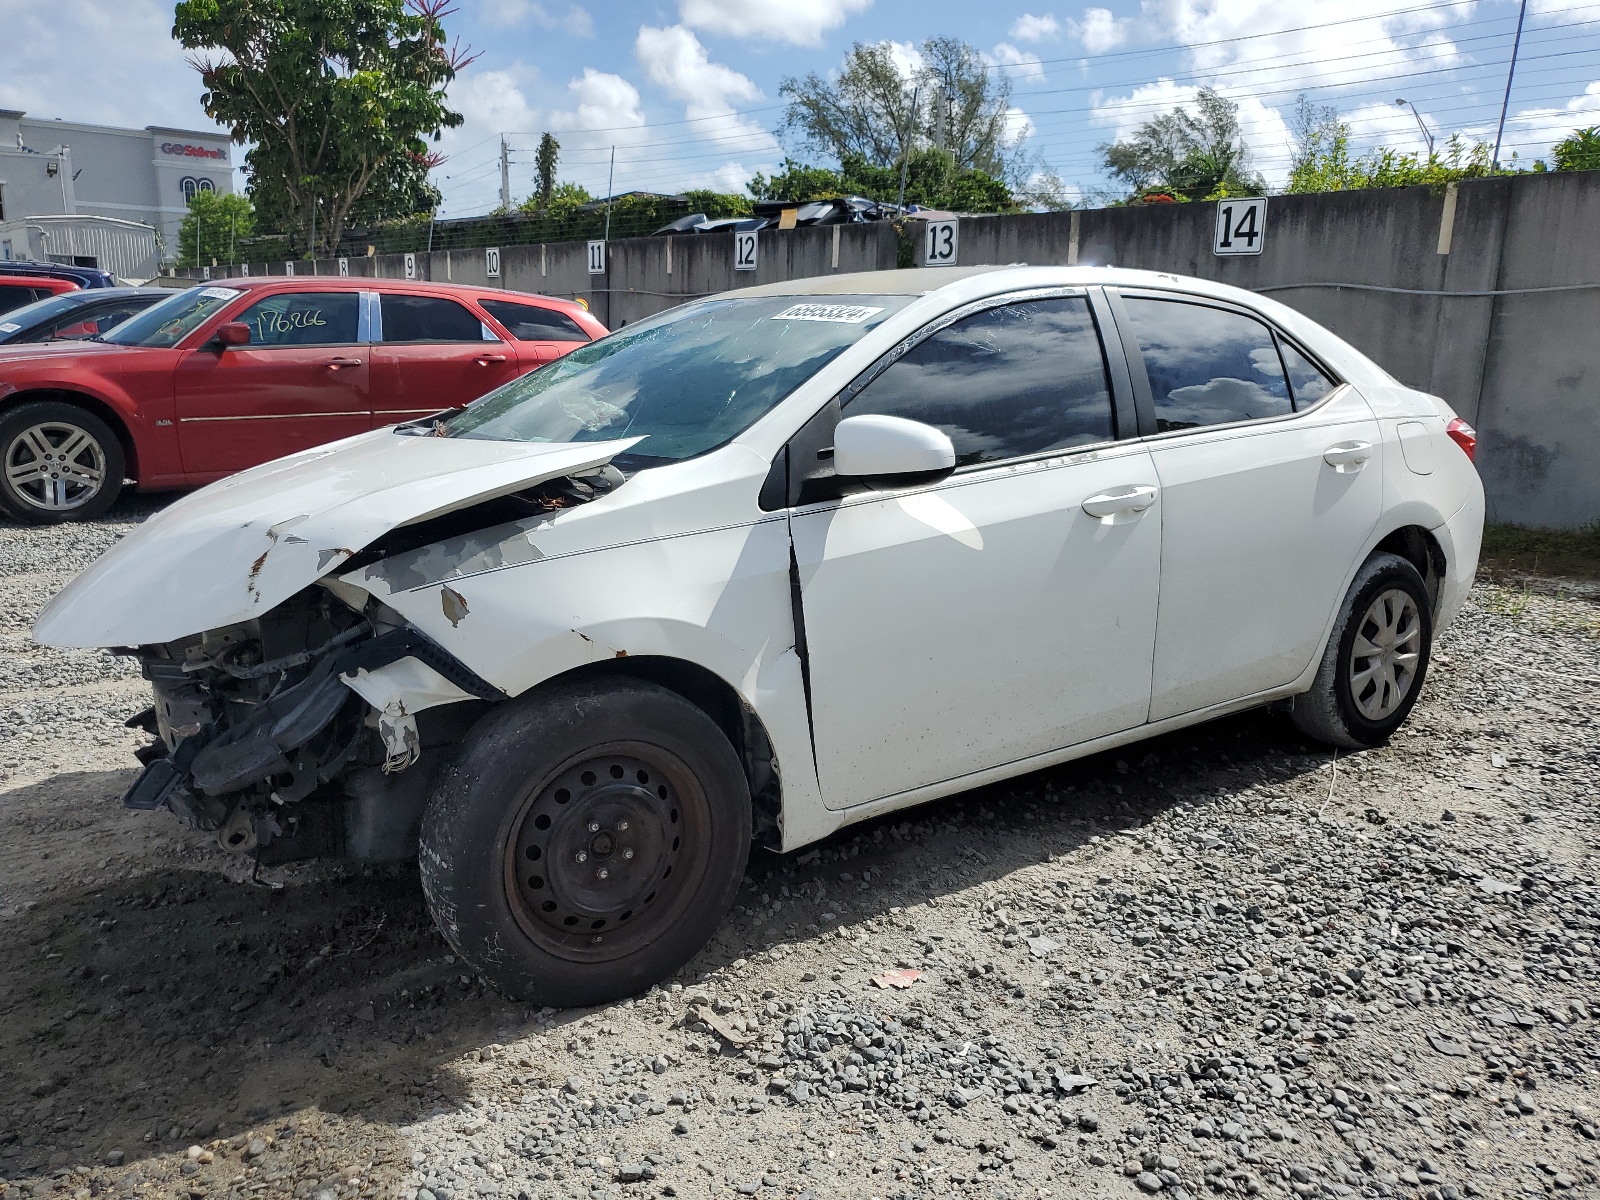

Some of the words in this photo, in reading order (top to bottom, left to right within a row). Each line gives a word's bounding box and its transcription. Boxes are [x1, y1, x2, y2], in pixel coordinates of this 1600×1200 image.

[1219, 205, 1259, 248] 14
[737, 236, 755, 265] 12
[929, 225, 954, 260] 13
[341, 261, 347, 277] 8
[406, 257, 413, 277] 9
[487, 251, 499, 274] 10
[590, 244, 603, 270] 11
[257, 310, 327, 341] 176,266
